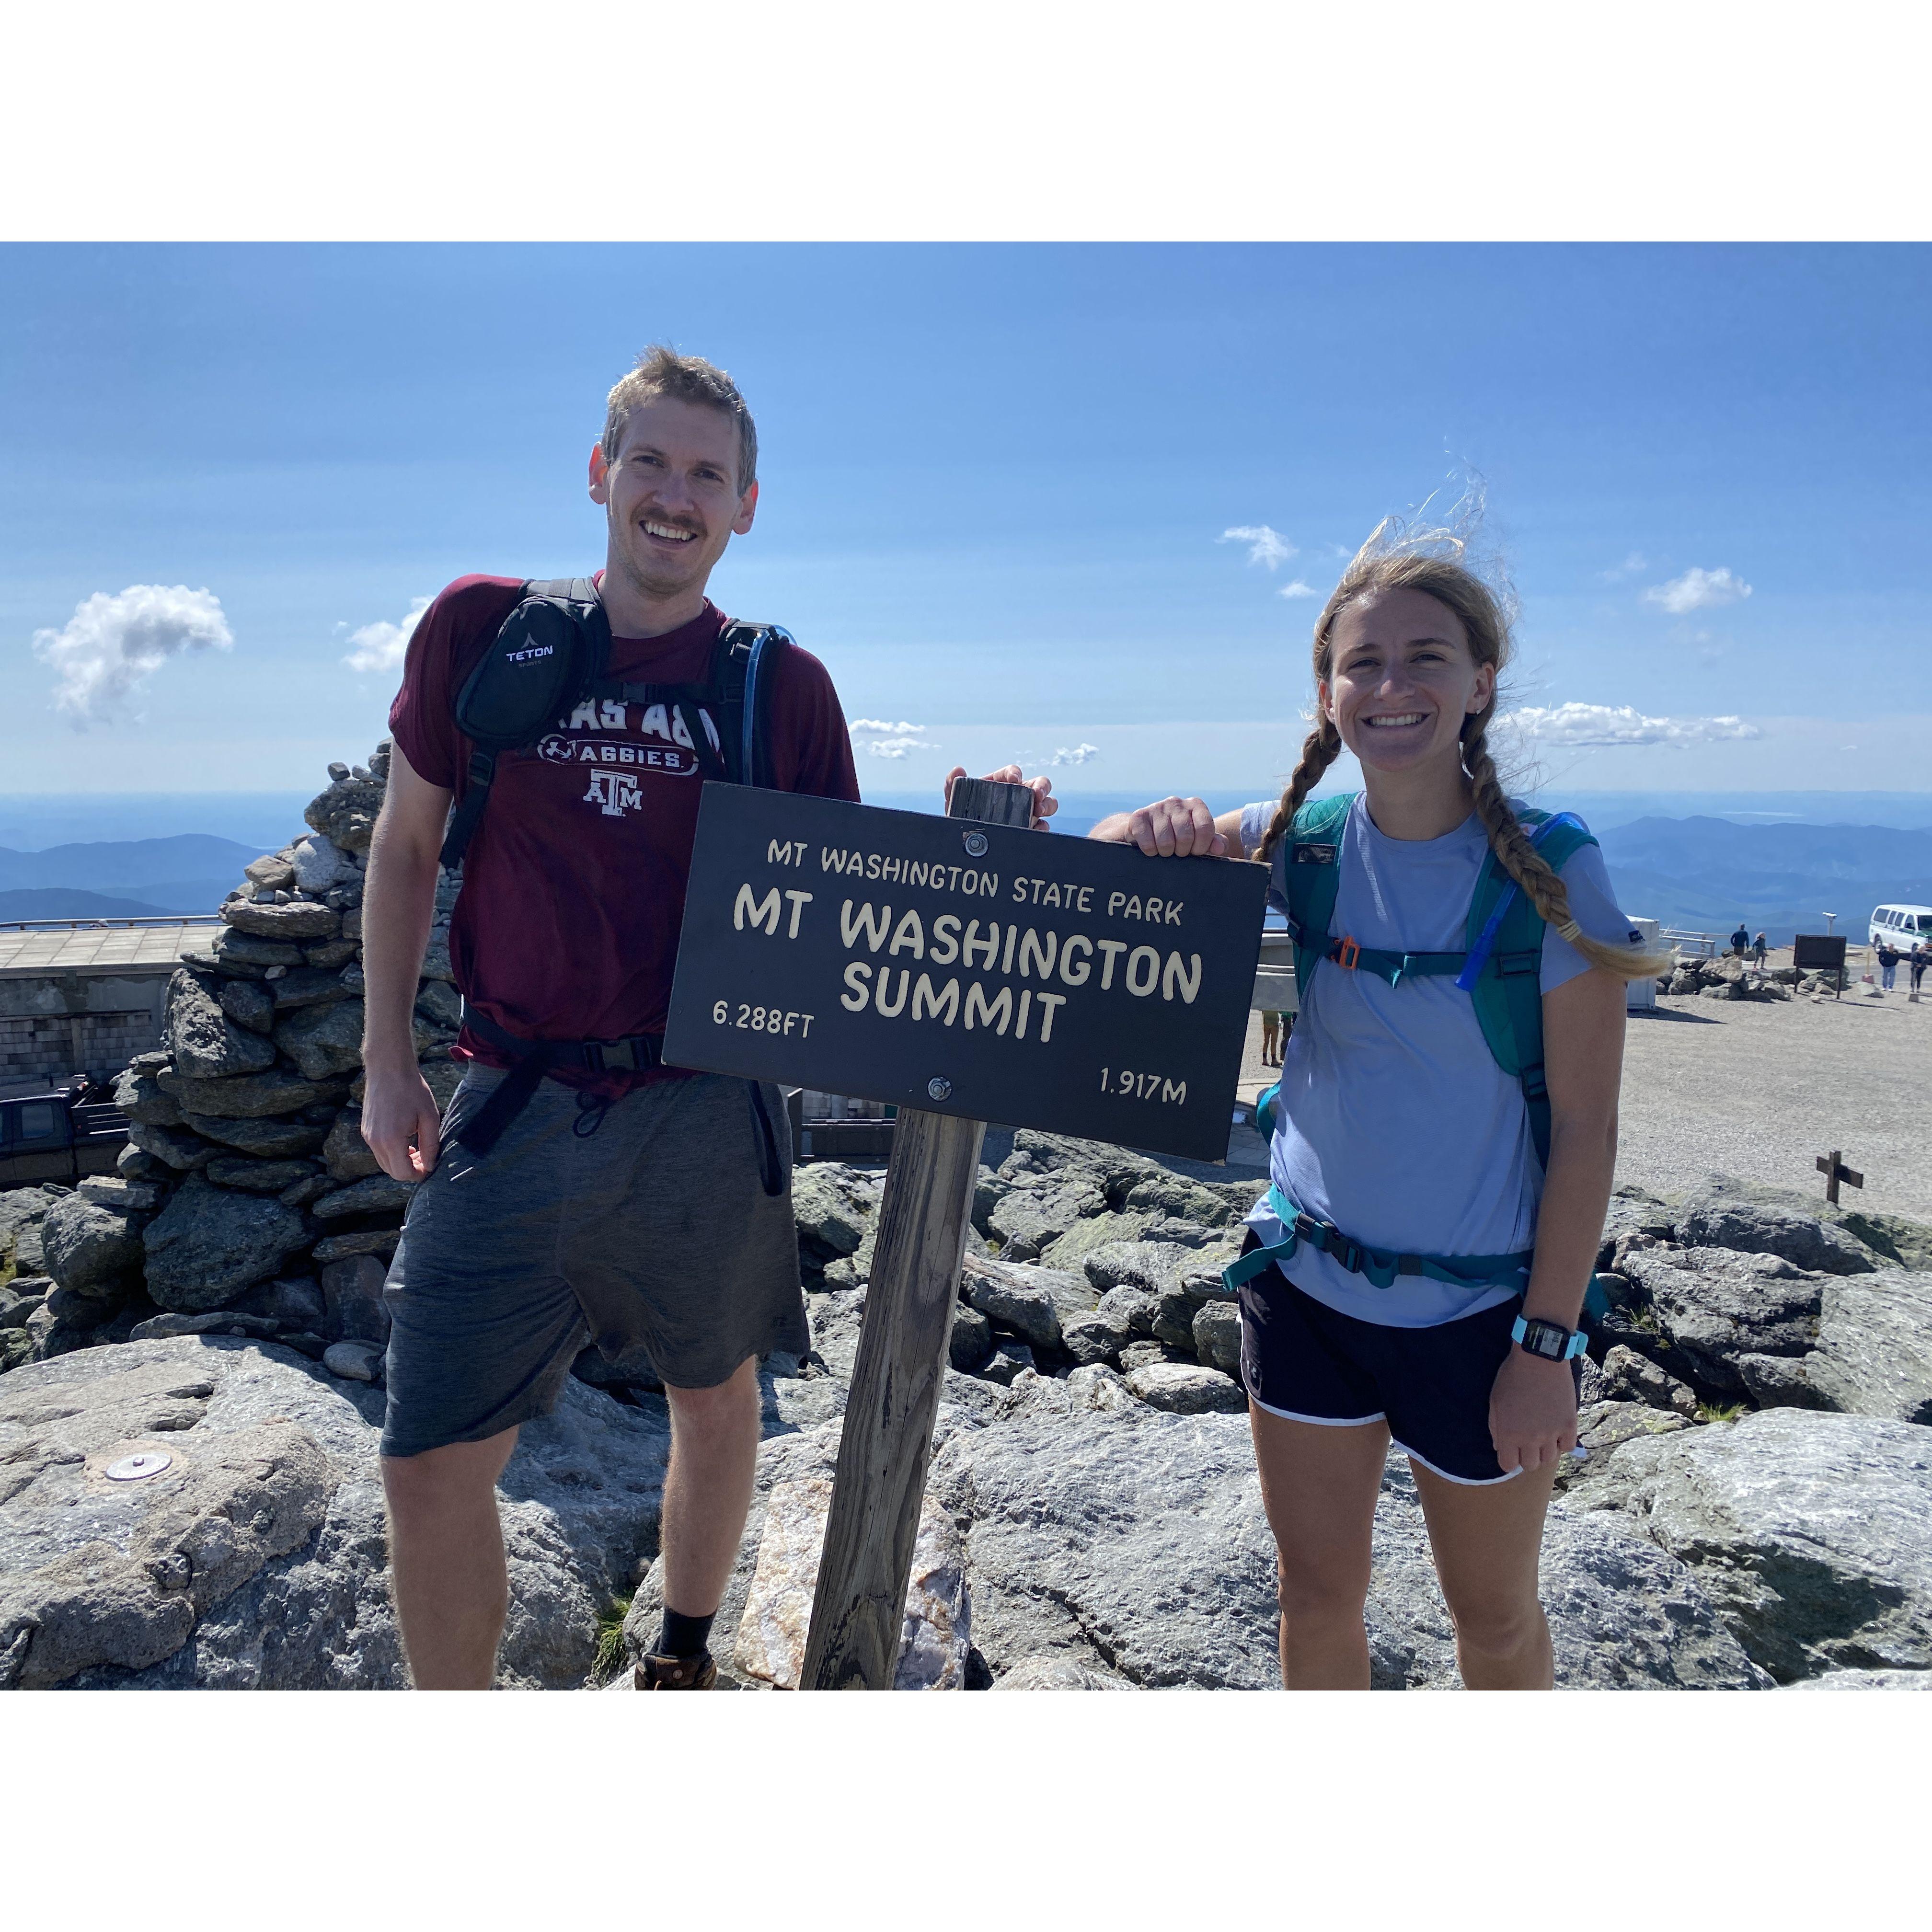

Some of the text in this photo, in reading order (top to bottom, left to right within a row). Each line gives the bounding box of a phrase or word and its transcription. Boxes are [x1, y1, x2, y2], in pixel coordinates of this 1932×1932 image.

[506, 645, 553, 662] TETON
[518, 660, 542, 668] SPORTS
[580, 746, 680, 768] AGGIES
[768, 839, 1184, 926] MT WASHINGTON STATE PARK
[733, 883, 1202, 1003] MT WASHINGTON
[840, 961, 1067, 1043] SUMMIT
